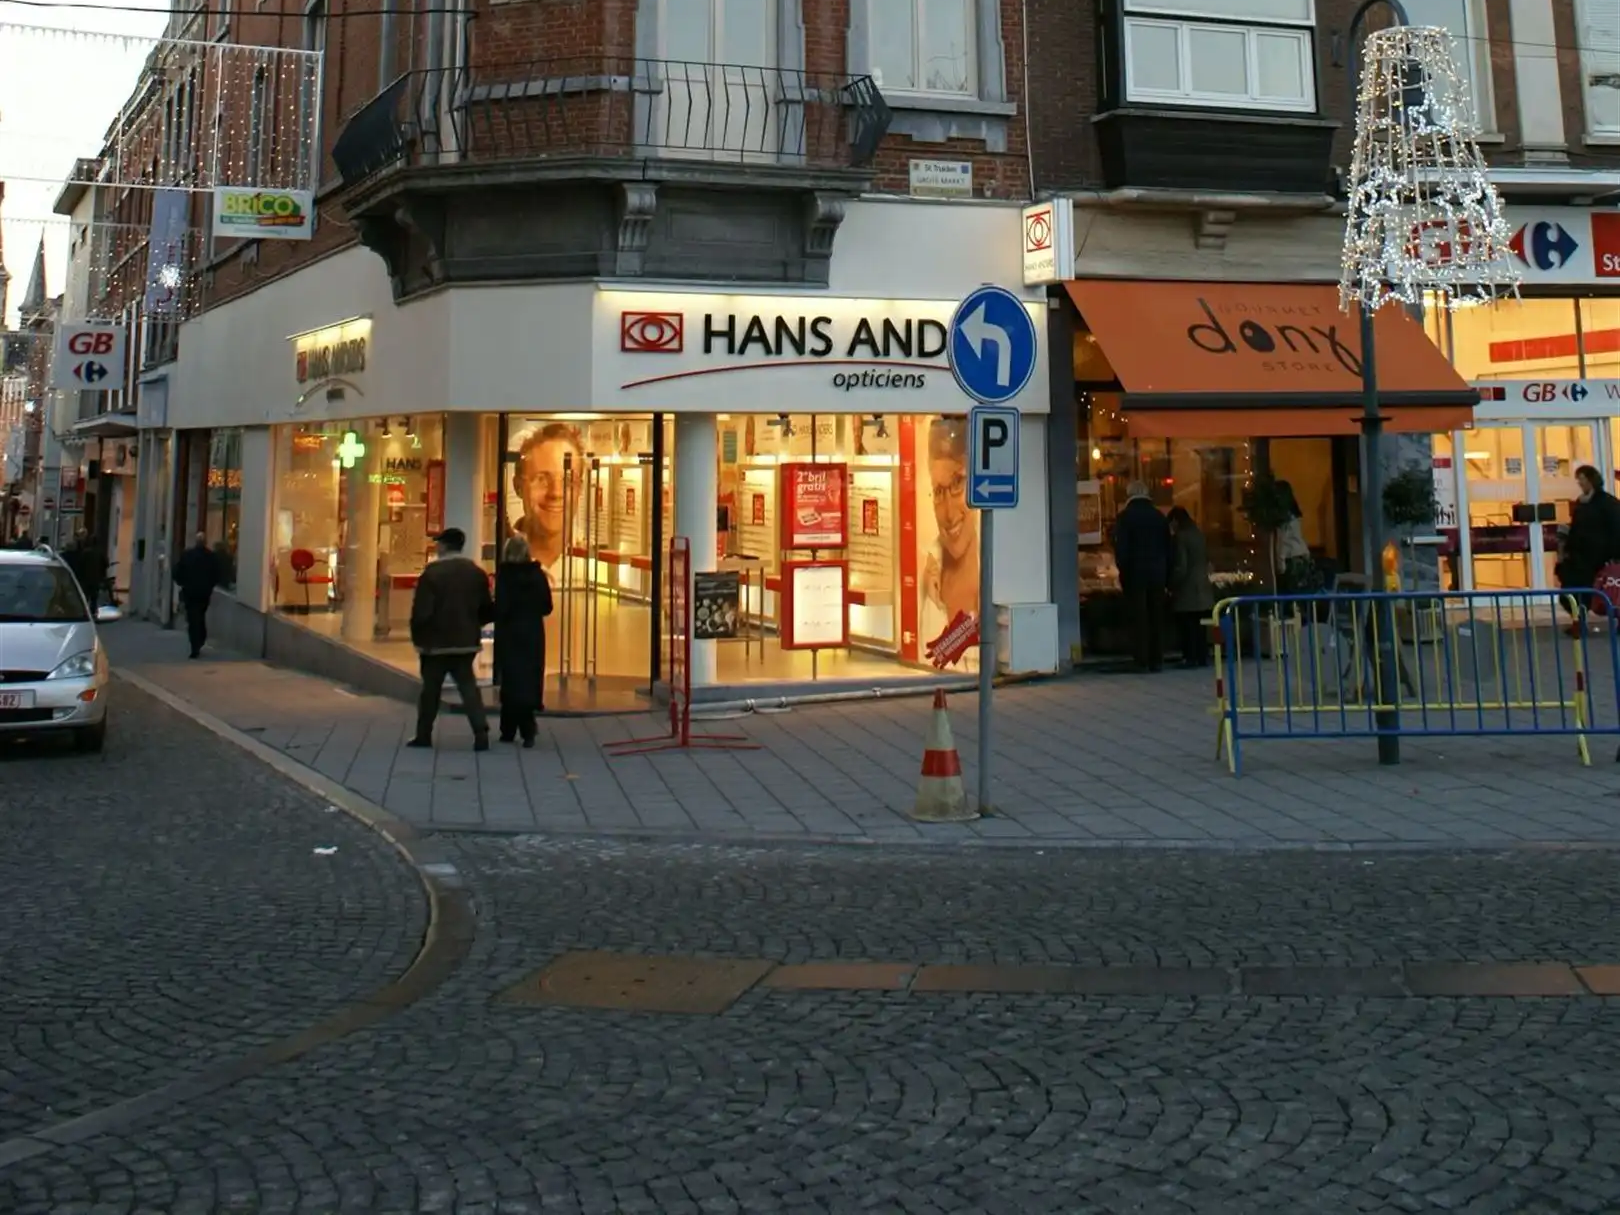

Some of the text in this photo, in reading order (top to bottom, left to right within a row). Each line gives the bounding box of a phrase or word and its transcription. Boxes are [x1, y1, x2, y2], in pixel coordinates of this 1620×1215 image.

[224, 193, 294, 217] BRICO
[69, 332, 114, 355] GB
[704, 313, 947, 358] HANS AND
[1262, 361, 1336, 373] STORE
[833, 368, 925, 391] opticiens
[1523, 383, 1556, 402] GB
[982, 418, 1008, 469] P
